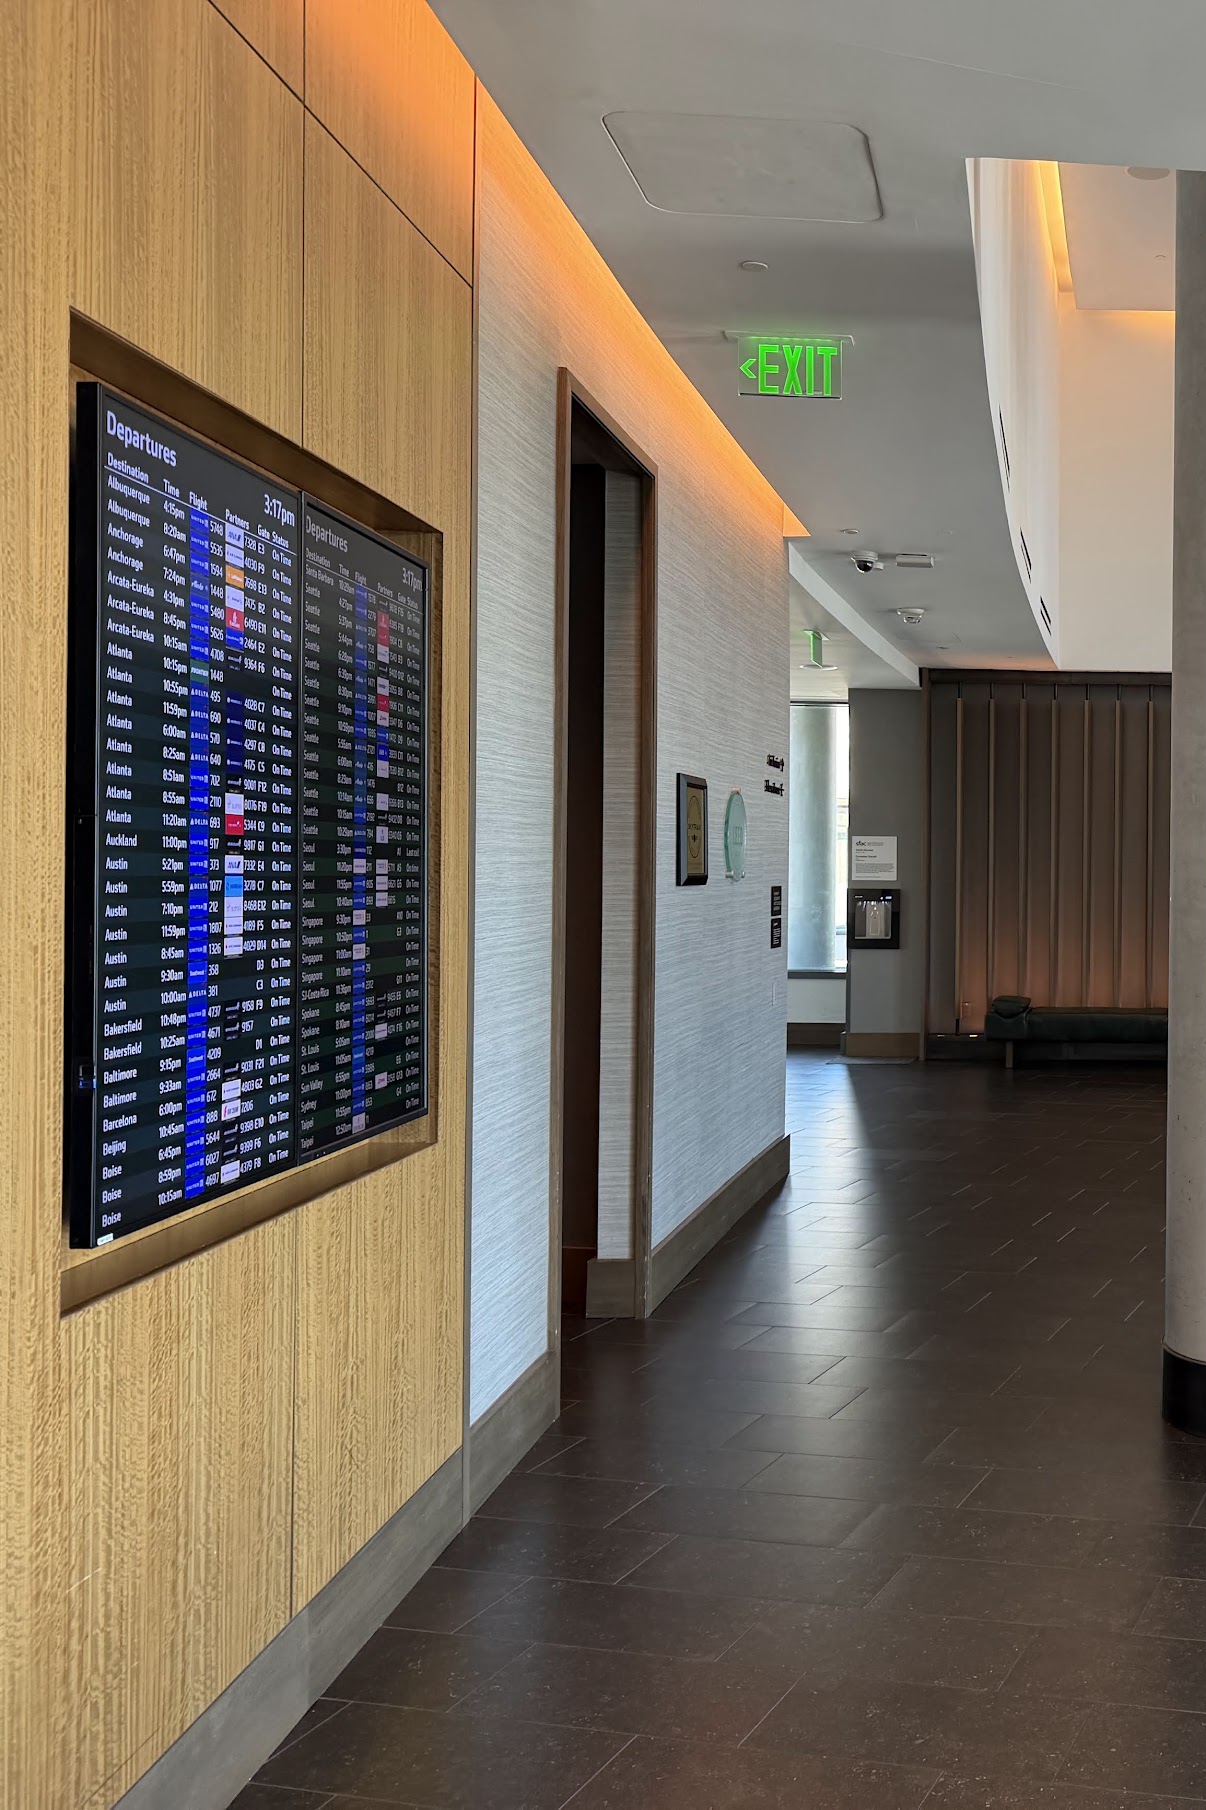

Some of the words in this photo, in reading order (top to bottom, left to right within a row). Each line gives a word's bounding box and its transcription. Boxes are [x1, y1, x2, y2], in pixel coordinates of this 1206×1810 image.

[758, 344, 838, 396] EXIT
[106, 410, 177, 467] Departures
[107, 452, 149, 483] Destination
[163, 479, 180, 498] Time
[189, 491, 208, 511] Flight
[225, 508, 250, 530] Partners
[257, 524, 270, 540] Gate
[272, 530, 289, 548] Status
[264, 493, 295, 527] 3:17pm
[108, 475, 150, 504] Albuquerque
[163, 500, 185, 520] 4:15pm
[272, 550, 280, 560] On
[280, 550, 292, 567] Time
[306, 515, 348, 553] Departures
[108, 499, 150, 528] Albuquerque
[163, 522, 187, 543] 8:20am
[272, 569, 280, 580] On
[280, 570, 292, 586] Time
[108, 522, 144, 549] Anchorage
[163, 544, 186, 564] 6:47pm
[272, 588, 280, 600] On
[280, 589, 292, 605] Time
[306, 564, 318, 578] Santa
[306, 548, 331, 569] Destination
[339, 564, 350, 577] Time
[354, 572, 367, 586] Flight
[377, 582, 394, 598] Partners
[107, 570, 154, 598] Arcata-Eureka
[163, 589, 185, 608] 4:31pm
[108, 546, 144, 572] Anchorage
[163, 566, 186, 586] 7:24pm
[272, 608, 280, 618] On
[280, 610, 292, 624] Time
[107, 594, 154, 620] Arcata-Eureka
[163, 612, 186, 630] 8:45pm
[107, 618, 154, 643] Arcata-Eureka
[163, 634, 188, 652] 10:15am
[106, 642, 133, 660] Atlanta
[163, 656, 188, 675] 10:15pm
[106, 666, 133, 684] Atlanta
[163, 679, 188, 697] 10:55pm
[106, 690, 133, 707] Atlanta
[162, 701, 188, 719] 11:59pm
[106, 713, 133, 730] Atlanta
[162, 724, 186, 740] 6:00am
[106, 738, 132, 754] Atlanta
[162, 746, 186, 762] 8:25am
[106, 760, 132, 777] Atlanta
[162, 768, 185, 783] 8:51am
[210, 774, 220, 787] 702
[106, 785, 132, 800] Atlanta
[162, 791, 186, 805] 8:55am
[106, 809, 132, 824] Atlanta
[162, 814, 187, 827] 11:20am
[106, 832, 138, 847] Auckland
[162, 836, 188, 851] 11:00pm
[106, 856, 128, 870] Austin
[162, 858, 184, 873] 5:21pm
[105, 880, 128, 894] Austin
[162, 880, 185, 896] 5:59pm
[104, 904, 128, 918] Austin
[162, 902, 184, 918] 7:10pm
[104, 928, 128, 942] Austin
[161, 924, 186, 940] 11:59pm
[104, 952, 128, 965] Austin
[160, 946, 184, 960] 8:45am
[104, 975, 127, 989] Austin
[160, 969, 184, 982] 9:30am
[104, 998, 127, 1013] Austin
[160, 991, 187, 1004] 10:00am
[270, 978, 278, 989] On
[279, 976, 290, 987] Time
[104, 1018, 142, 1036] Bakersfield
[160, 1012, 187, 1027] 10:48pm
[270, 997, 278, 1008] On
[278, 996, 291, 1006] Time
[104, 1042, 142, 1060] Bakersfield
[160, 1035, 186, 1050] 10:25am
[103, 1068, 138, 1085] Baltimore
[160, 1058, 182, 1072] 9:15pm
[103, 1090, 138, 1108] Baltimore
[159, 1080, 182, 1094] 9:33am
[102, 1114, 138, 1132] Barcelona
[158, 1102, 182, 1117] 6:00pm
[102, 1140, 127, 1156] Beijing
[158, 1124, 185, 1139] 10:45am
[102, 1164, 122, 1180] Boise
[158, 1146, 182, 1161] 6:45pm
[102, 1188, 122, 1204] Boise
[158, 1168, 182, 1184] 8:59pm
[102, 1212, 122, 1228] Boise
[158, 1189, 182, 1206] 10:15am
[268, 1152, 276, 1164] On
[276, 1150, 289, 1162] Time
